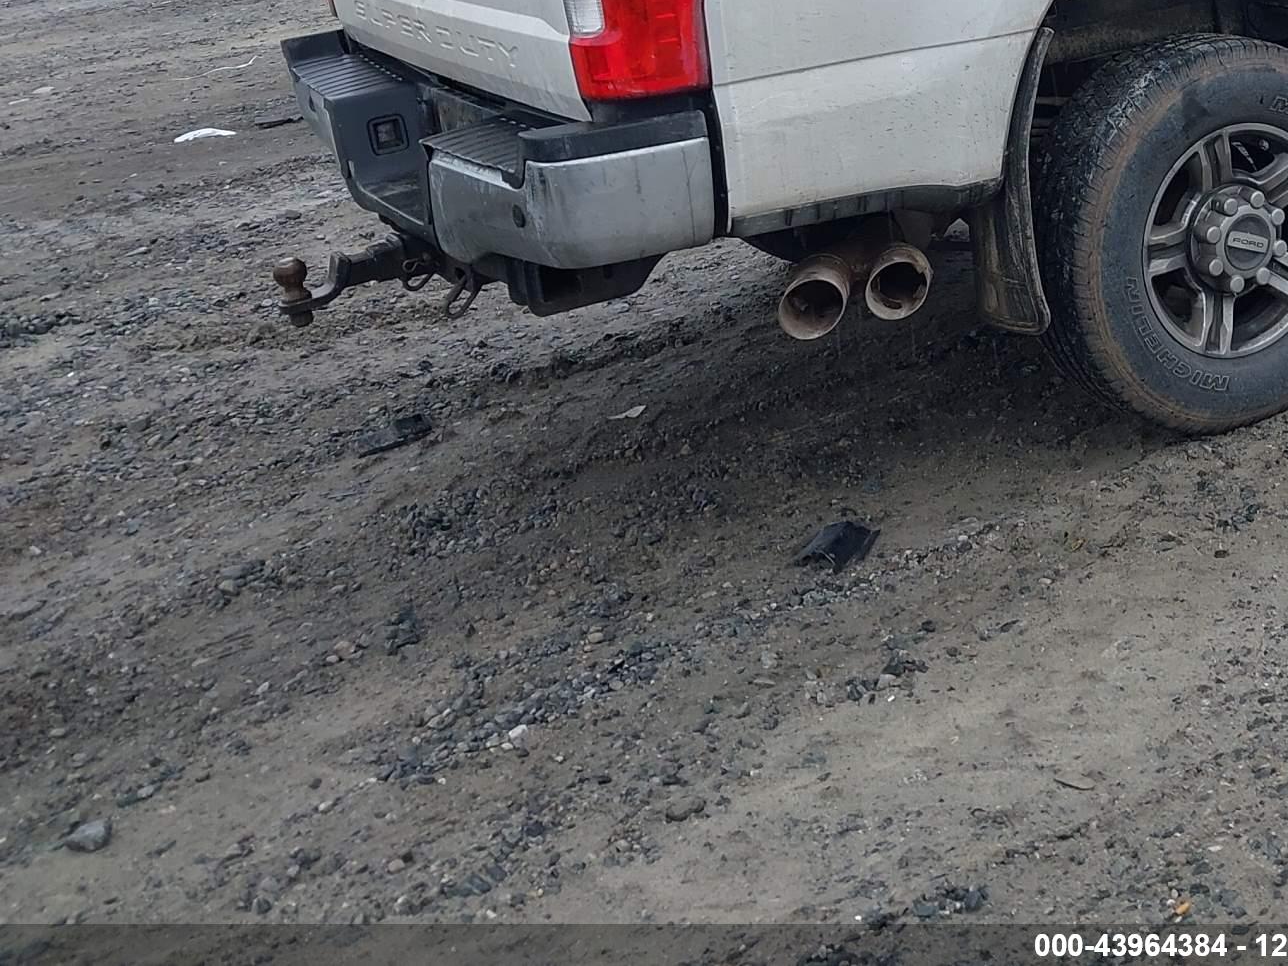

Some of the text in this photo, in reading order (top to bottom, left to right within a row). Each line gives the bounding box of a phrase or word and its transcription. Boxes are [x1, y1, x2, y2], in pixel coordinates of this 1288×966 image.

[354, 0, 519, 68] SUPER DUTY
[1232, 237, 1265, 249] FORD
[1126, 276, 1230, 391] MICHELIN
